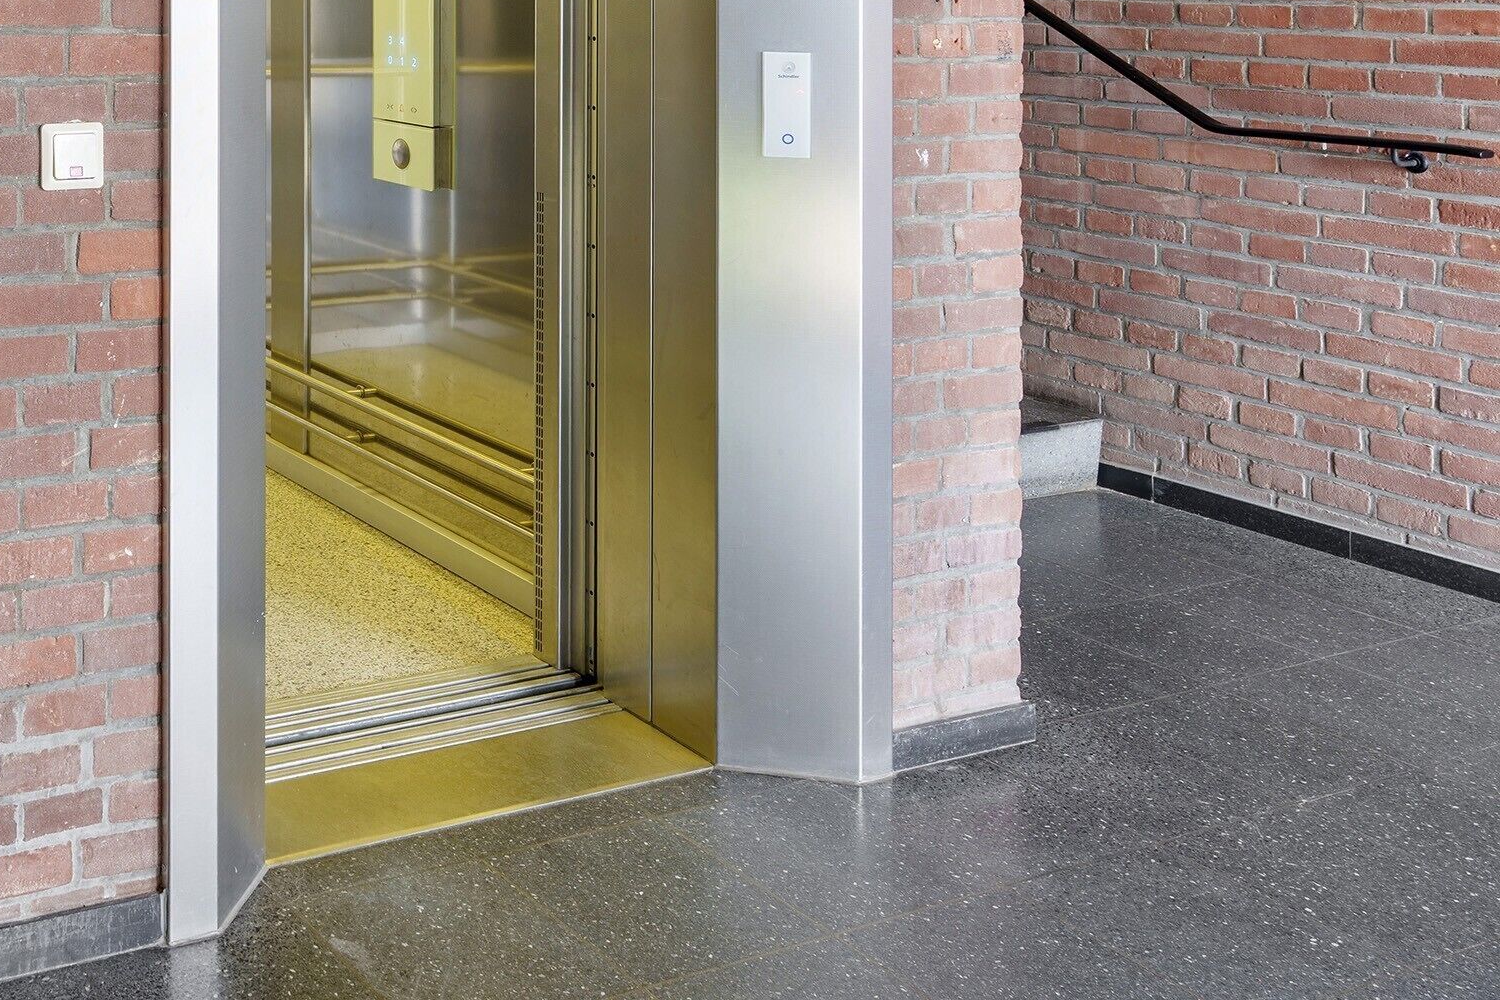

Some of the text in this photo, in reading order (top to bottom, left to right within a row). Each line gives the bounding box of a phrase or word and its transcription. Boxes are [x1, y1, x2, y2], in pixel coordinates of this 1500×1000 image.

[387, 35, 393, 45] 3
[387, 55, 393, 65] 0
[411, 57, 417, 67] 2
